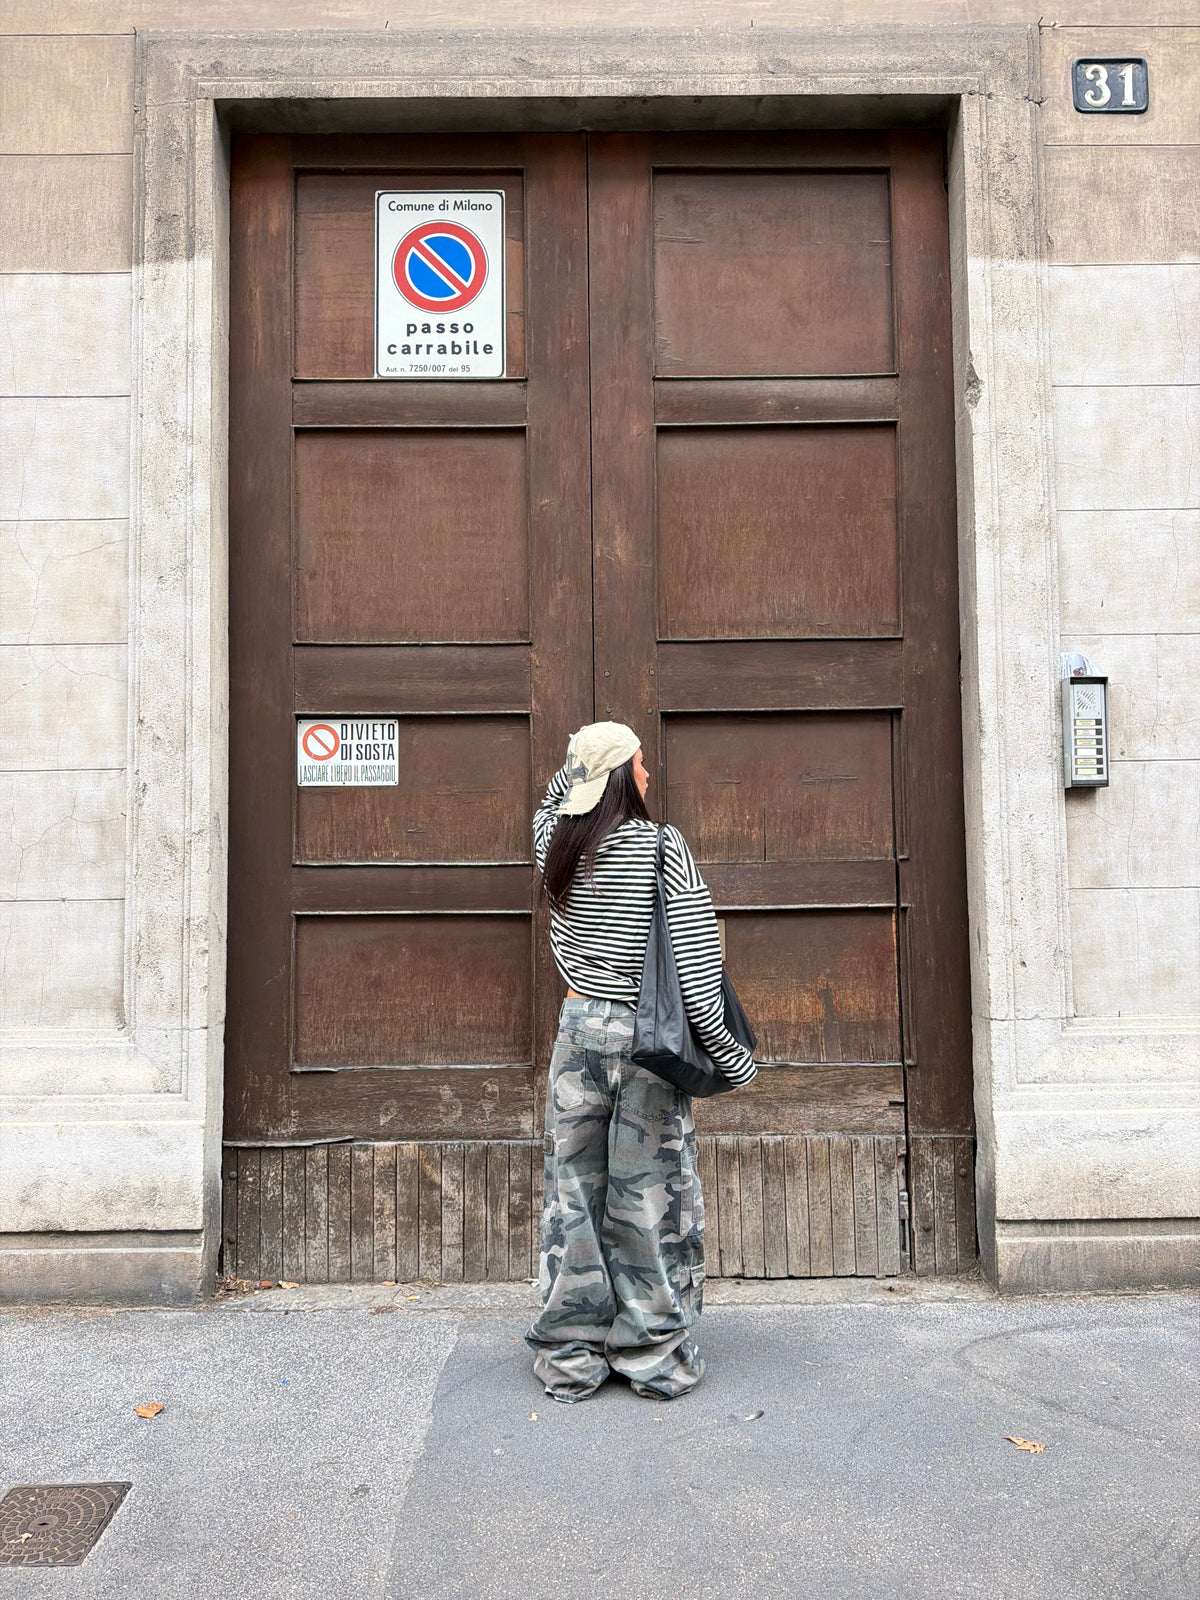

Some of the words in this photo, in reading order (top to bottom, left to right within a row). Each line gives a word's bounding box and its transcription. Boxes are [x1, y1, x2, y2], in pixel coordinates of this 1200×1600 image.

[1084, 64, 1136, 107] 31
[388, 200, 435, 212] Comune
[438, 199, 449, 211] di
[453, 199, 493, 211] Milano
[406, 322, 474, 337] passo
[387, 340, 494, 355] carrabile
[409, 364, 446, 373] 7250/007
[461, 364, 470, 373] 95
[340, 723, 395, 741] DIVIETO
[340, 743, 352, 761] DI
[355, 743, 395, 761] SOSTA
[300, 765, 329, 782] LASCIARE
[331, 765, 352, 782] LIBERO
[353, 765, 361, 782] IL
[361, 765, 396, 782] PASSAGGIO
